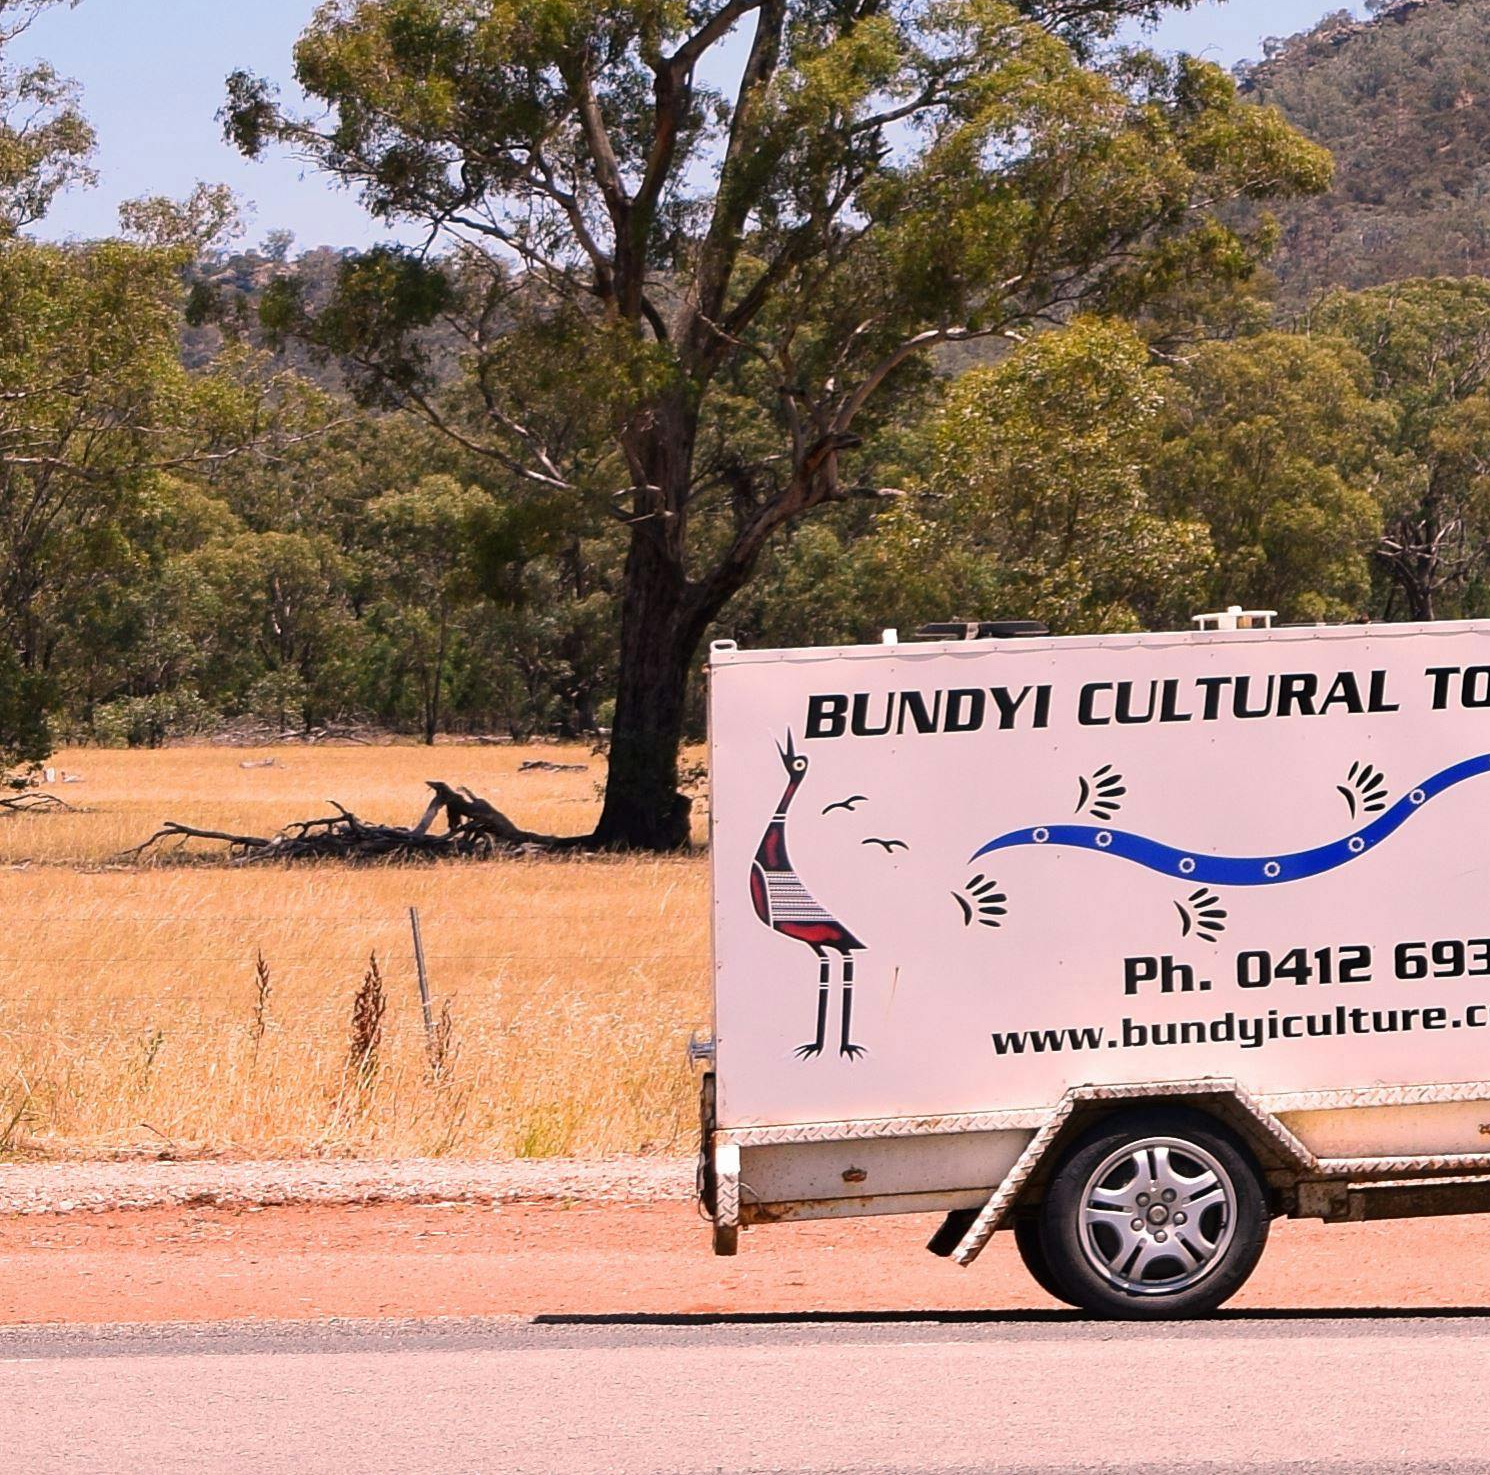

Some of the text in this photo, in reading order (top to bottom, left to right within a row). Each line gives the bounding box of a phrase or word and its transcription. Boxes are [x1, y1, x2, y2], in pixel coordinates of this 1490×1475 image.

[805, 685, 1051, 738] BUNDYI
[1078, 671, 1399, 725] CULTURAL
[1125, 956, 1211, 994] Ph.
[1237, 946, 1371, 988] 0412
